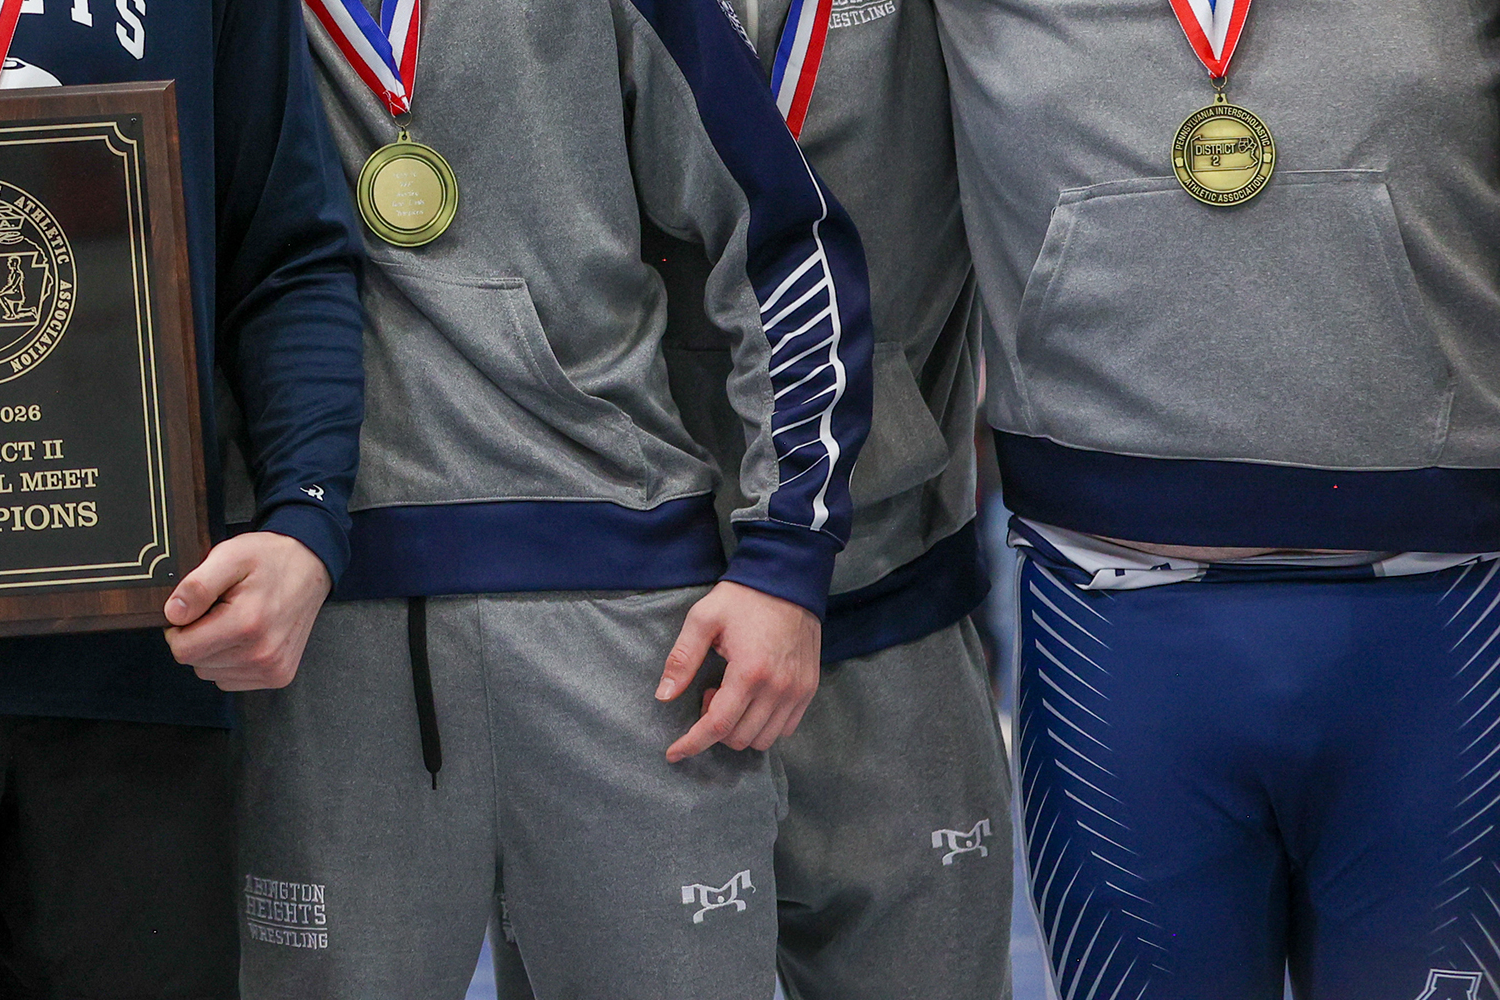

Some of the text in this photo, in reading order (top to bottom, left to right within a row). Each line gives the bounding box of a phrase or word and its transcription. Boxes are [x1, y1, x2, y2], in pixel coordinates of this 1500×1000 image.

[829, 0, 896, 29] ESTLING
[1175, 107, 1270, 150] PENNSYLVANIA INTERSCHOLASTIC
[1195, 143, 1236, 156] DISTRICT
[1212, 155, 1220, 166] 2
[1184, 174, 1265, 203] ATHLETIC ASSOCIATION
[13, 196, 70, 265] ATHLETIC
[10, 279, 73, 373] ASSOCIATION
[42, 439, 65, 460] II
[19, 467, 99, 493] MEET
[244, 874, 326, 904] ABINGTON
[245, 894, 327, 925] HEIGHTS
[247, 922, 329, 950] WRESTLING
